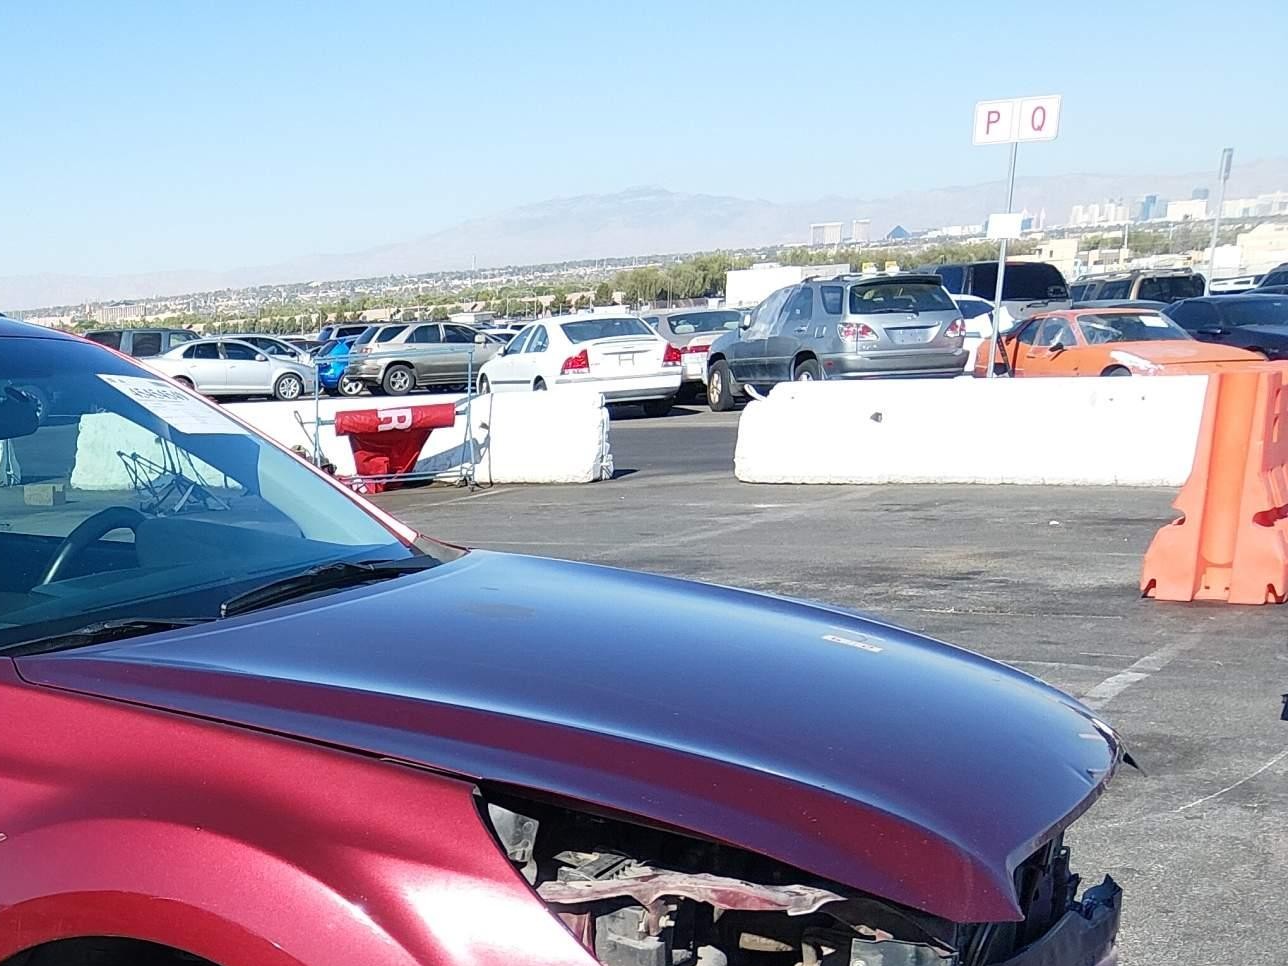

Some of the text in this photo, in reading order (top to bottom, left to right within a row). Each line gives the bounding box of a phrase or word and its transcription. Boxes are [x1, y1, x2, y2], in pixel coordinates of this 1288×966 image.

[985, 105, 1047, 135] P Q
[377, 407, 413, 432] R
